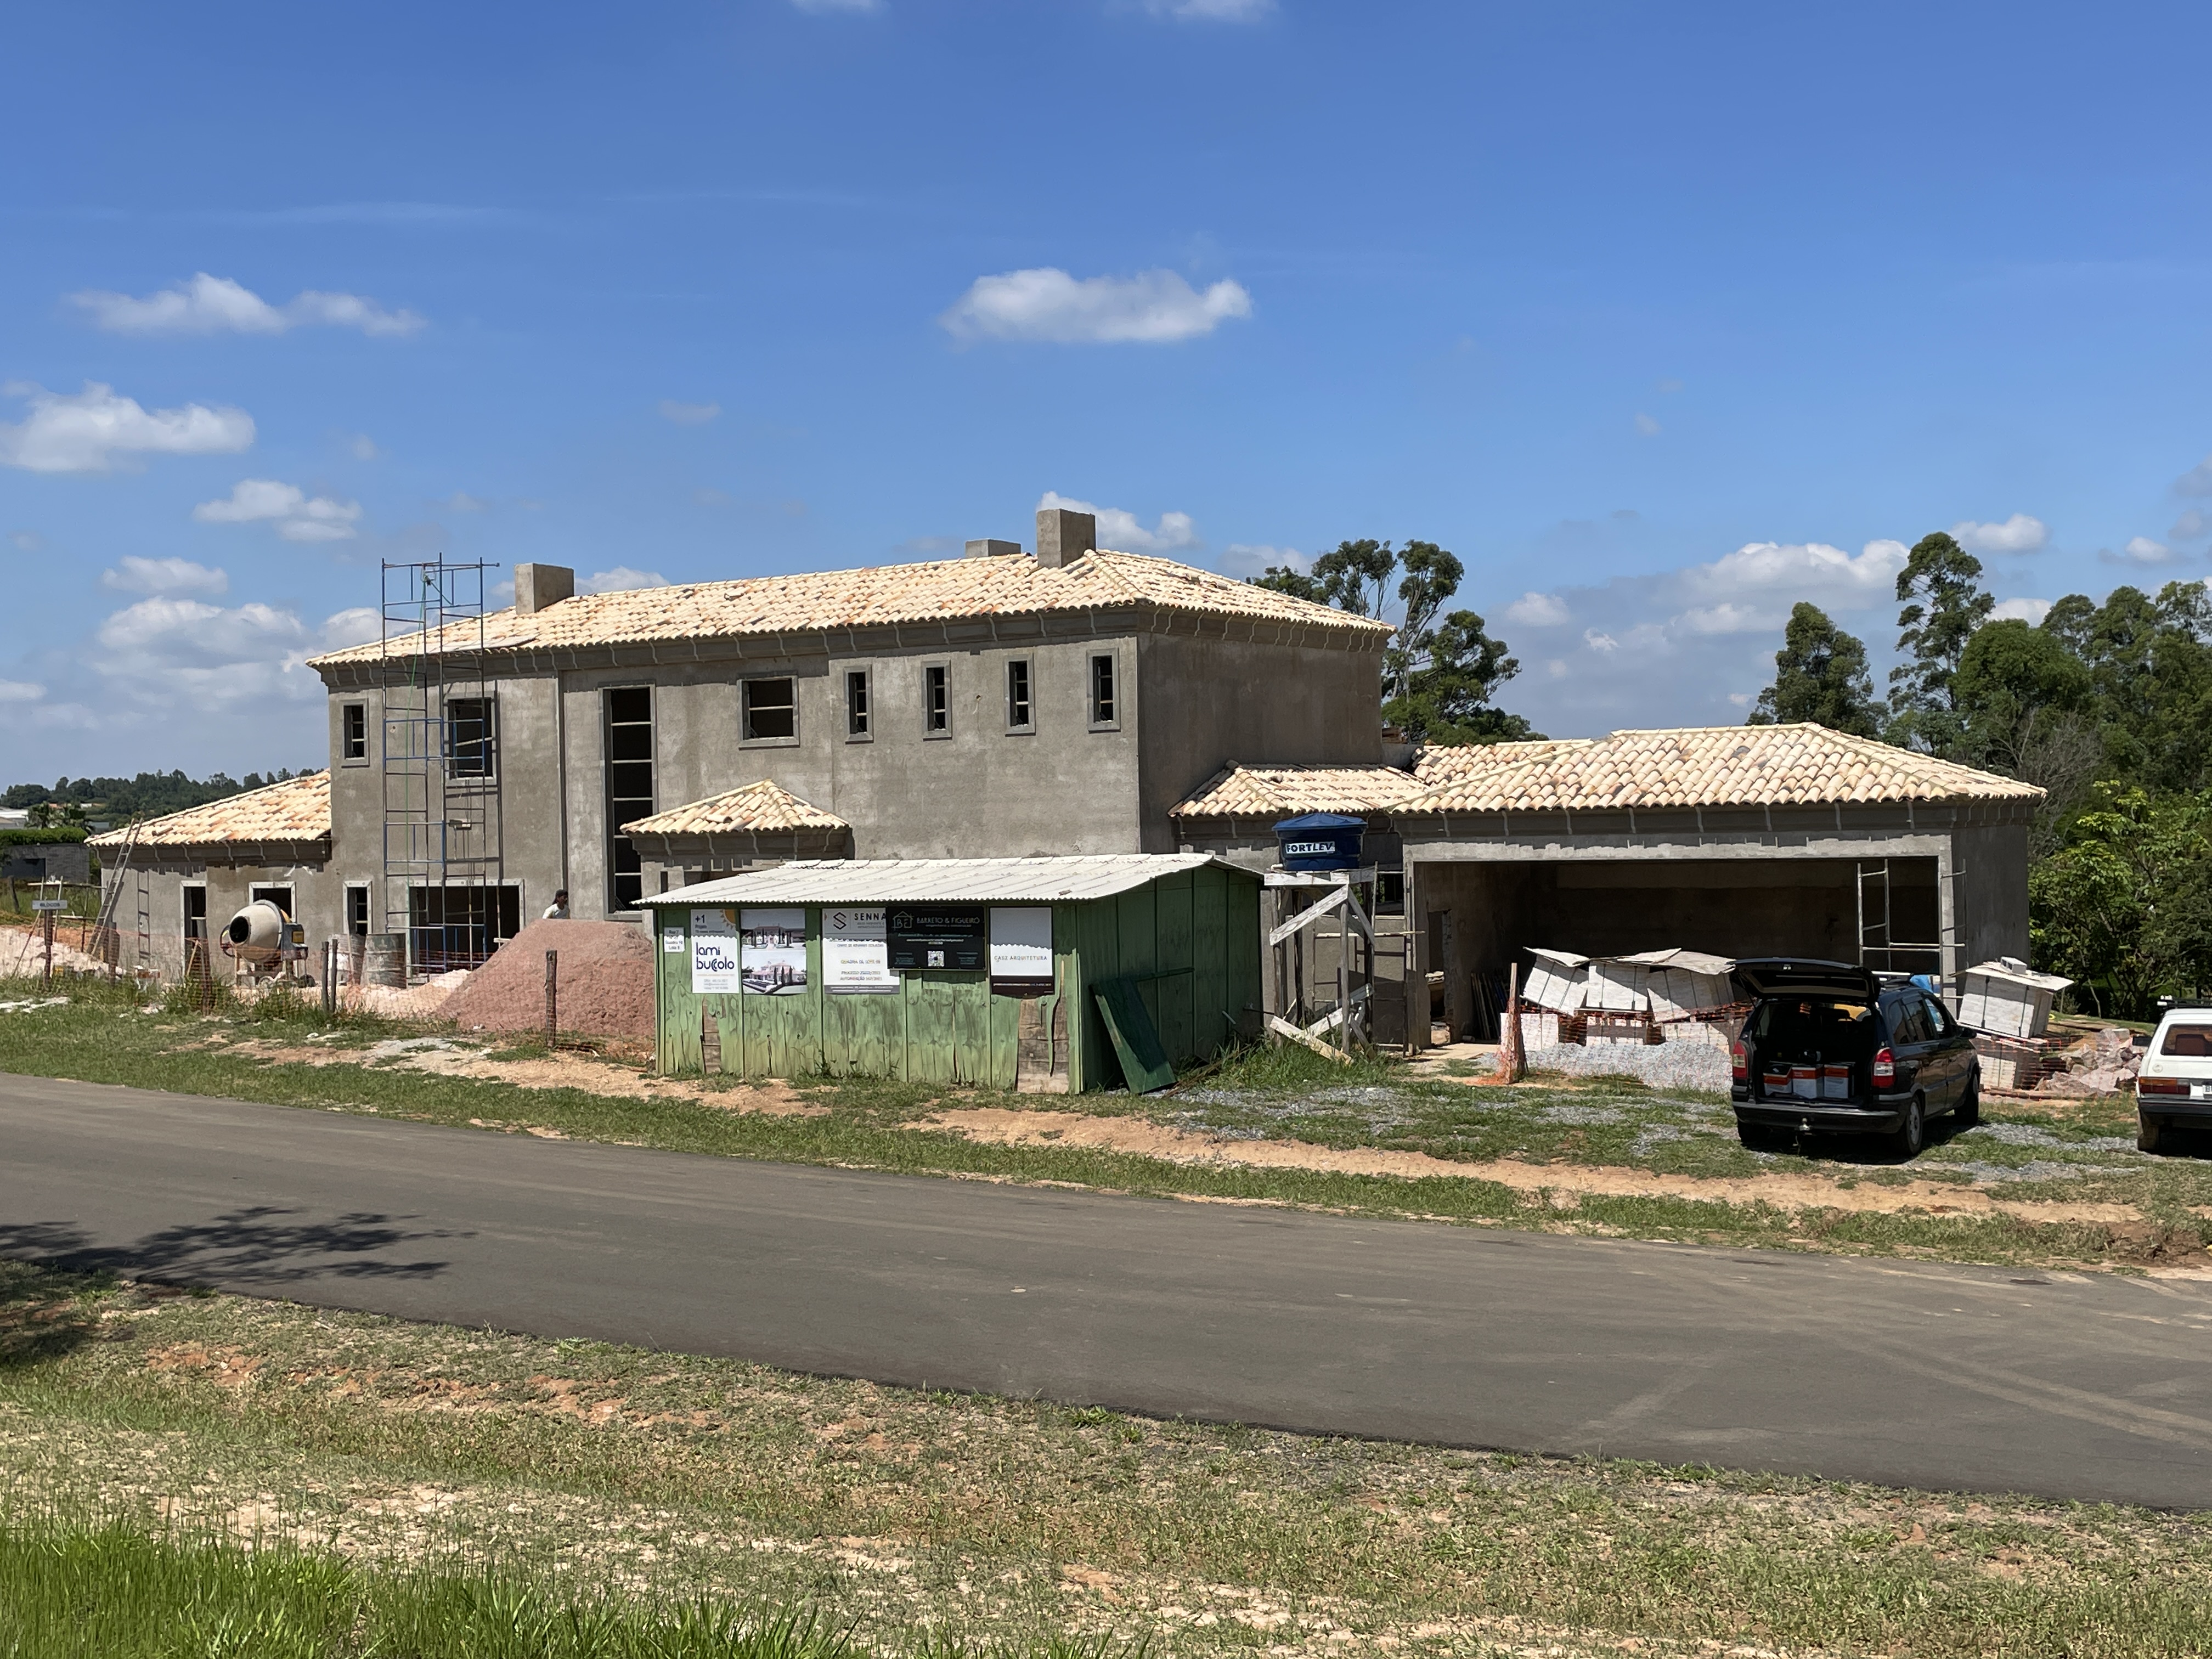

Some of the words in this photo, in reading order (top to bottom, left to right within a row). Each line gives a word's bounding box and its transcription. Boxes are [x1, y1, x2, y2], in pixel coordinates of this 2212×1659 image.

[1286, 843, 1333, 853] FORTLEV
[695, 915, 705, 923] +1
[696, 942, 720, 955] lami
